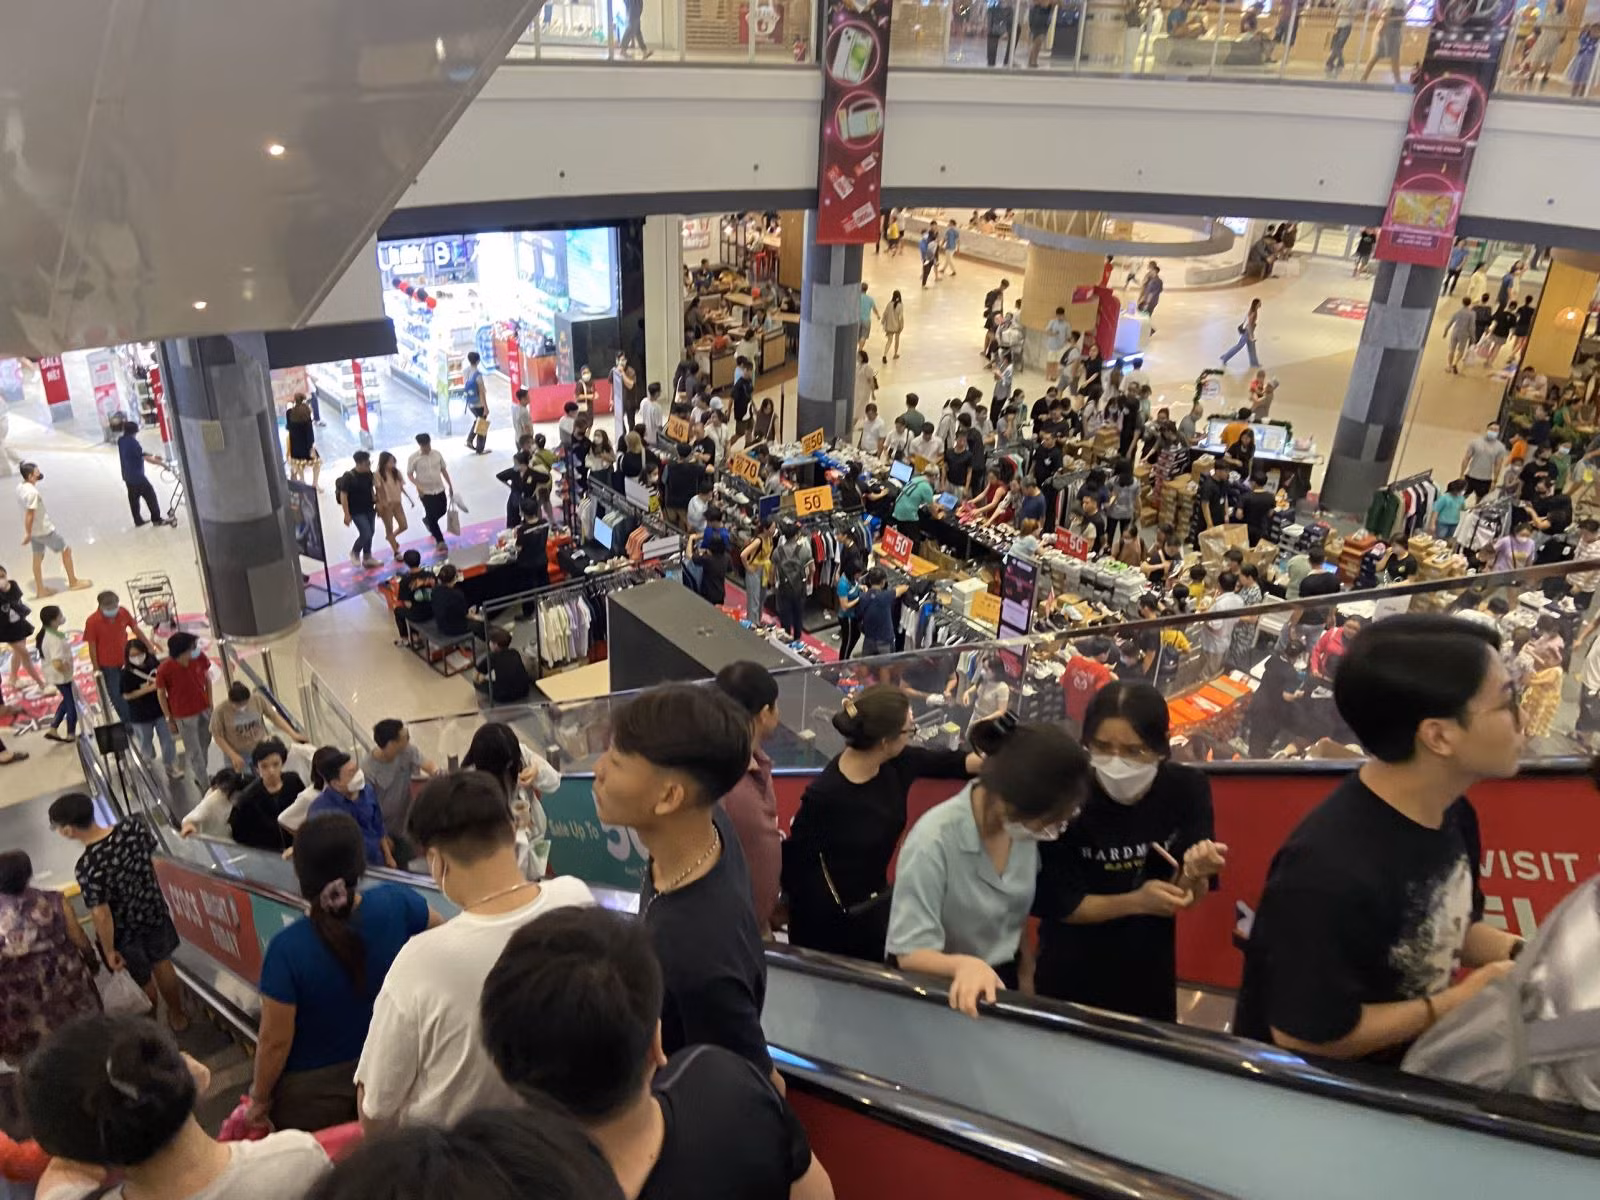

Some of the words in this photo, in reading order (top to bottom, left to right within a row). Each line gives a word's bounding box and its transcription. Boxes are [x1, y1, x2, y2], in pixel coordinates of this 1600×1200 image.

[744, 461, 758, 479] 70
[804, 494, 821, 511] 50
[894, 535, 908, 557] 50
[1069, 534, 1084, 554] 50
[1479, 849, 1580, 884] VISIT
